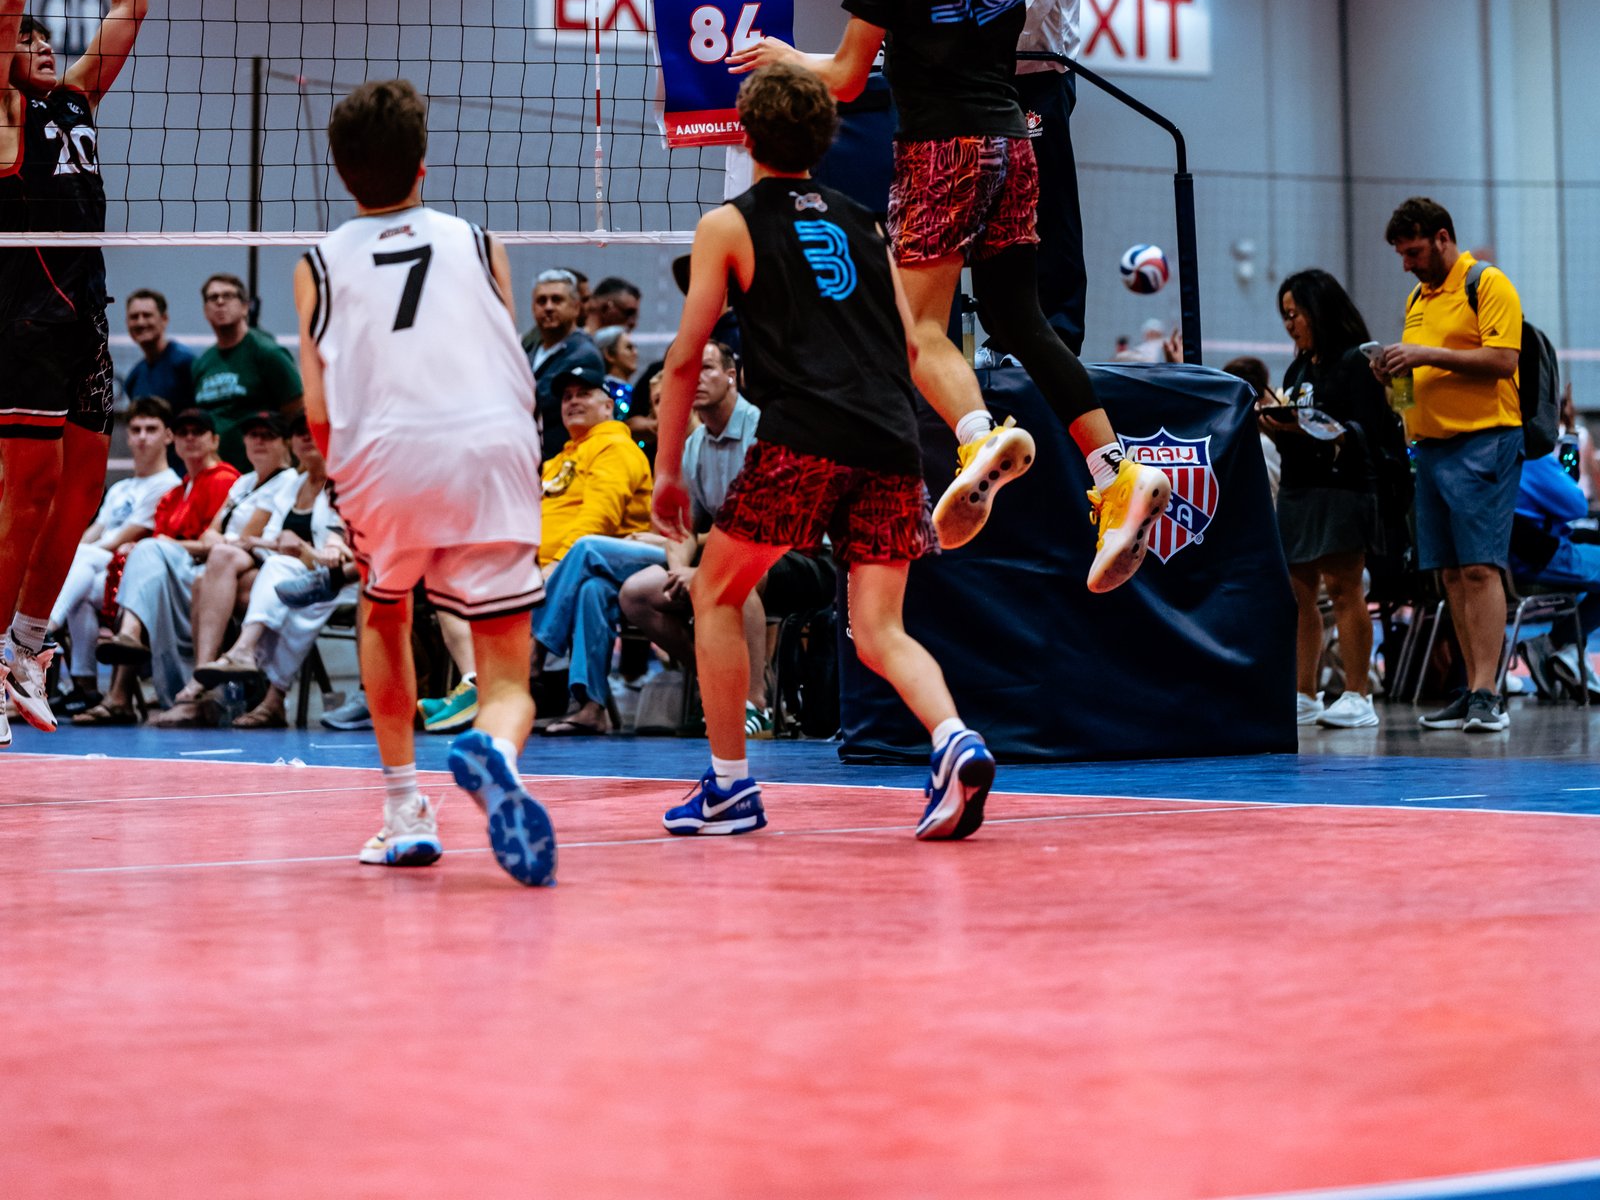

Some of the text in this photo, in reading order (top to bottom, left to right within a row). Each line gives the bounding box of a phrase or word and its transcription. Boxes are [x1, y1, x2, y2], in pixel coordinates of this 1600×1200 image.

[688, 2, 766, 64] 84
[371, 243, 433, 332] 7
[793, 219, 857, 301] 3
[1137, 447, 1193, 461] AAU
